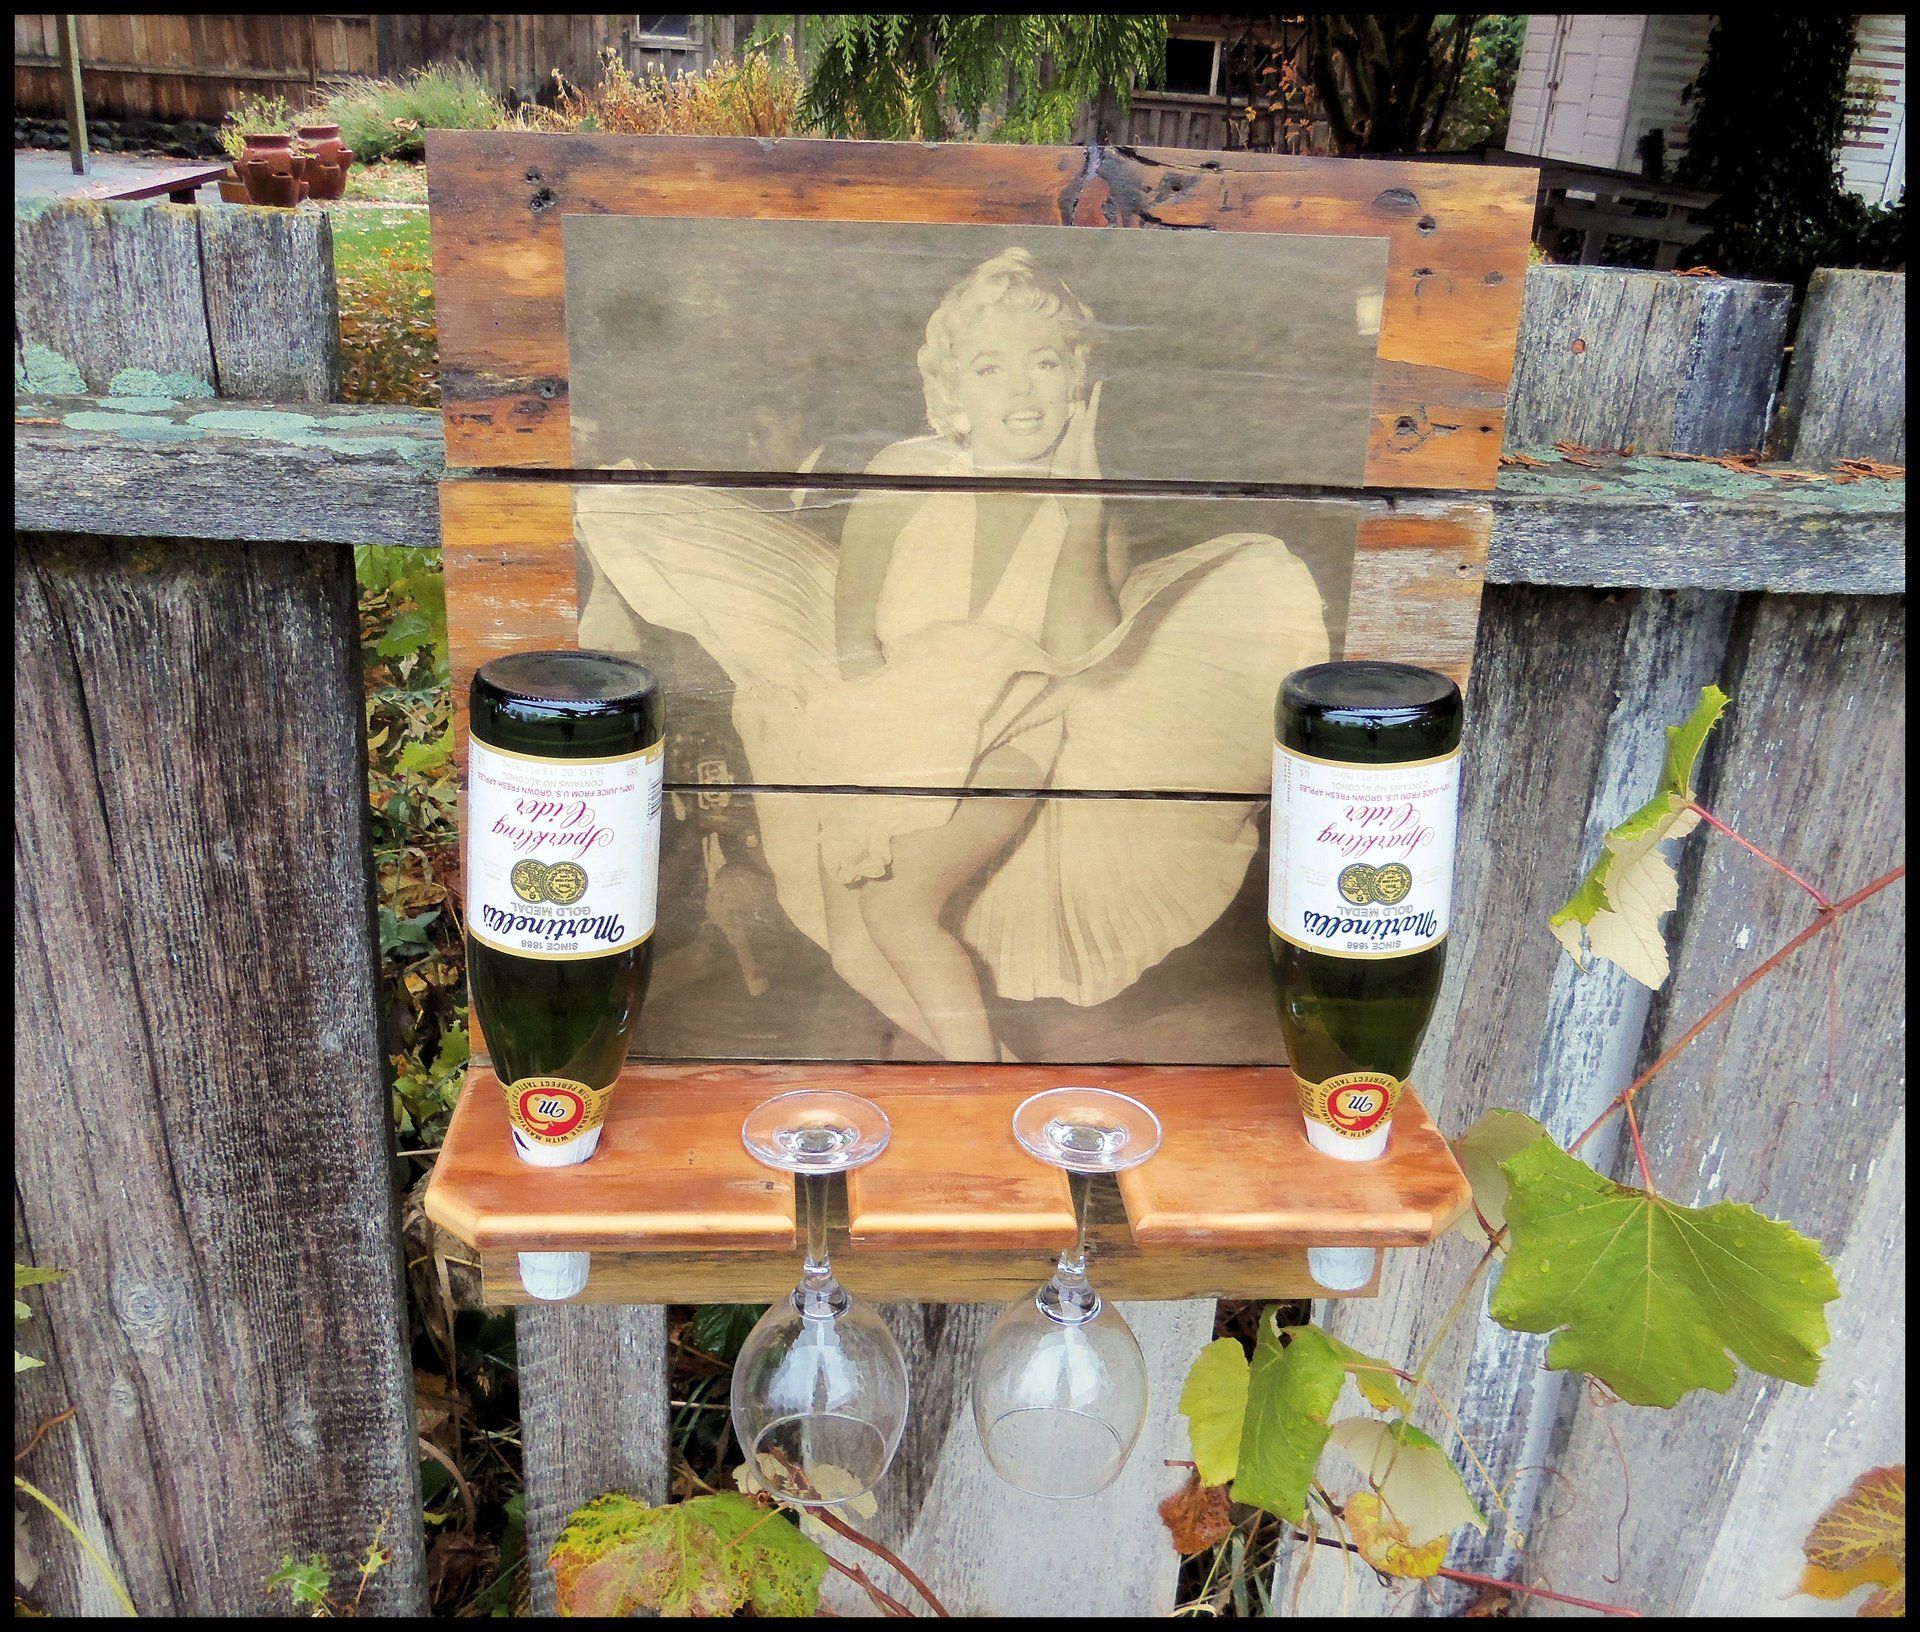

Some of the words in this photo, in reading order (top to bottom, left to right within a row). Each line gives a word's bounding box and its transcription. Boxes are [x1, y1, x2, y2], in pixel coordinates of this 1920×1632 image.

[501, 771, 540, 786] ALCOHOL
[559, 779, 603, 787] CONTAINS
[498, 780, 520, 793] FRESH
[1299, 784, 1324, 795] APPLES
[1330, 782, 1371, 792] ALCOHOL
[1390, 781, 1429, 791] CONTAINS
[521, 787, 552, 797] GROWN
[571, 790, 595, 798] FROM
[596, 787, 618, 796] JUICE
[1326, 792, 1350, 801] FRESH
[1401, 791, 1420, 800] FROM
[1352, 794, 1382, 802] GROWN
[513, 798, 595, 829] Cider
[1343, 802, 1420, 832] Cider
[491, 814, 615, 860] Sparkling
[1316, 823, 1435, 861] Sparkling
[510, 902, 553, 916] MEDAL
[556, 906, 591, 916] GOLD
[1336, 906, 1379, 917] MEDAL
[1382, 905, 1414, 916] GOLD
[520, 940, 543, 950] 1868
[545, 942, 578, 951] SINCE
[1346, 941, 1369, 950] 1868
[1372, 940, 1401, 950] SINCE
[1328, 1078, 1349, 1089] TASTE
[1354, 1076, 1387, 1085] PERFECT
[518, 1081, 536, 1092] TASTE
[540, 1081, 577, 1091] PERFECT
[1350, 1129, 1371, 1138] WITH
